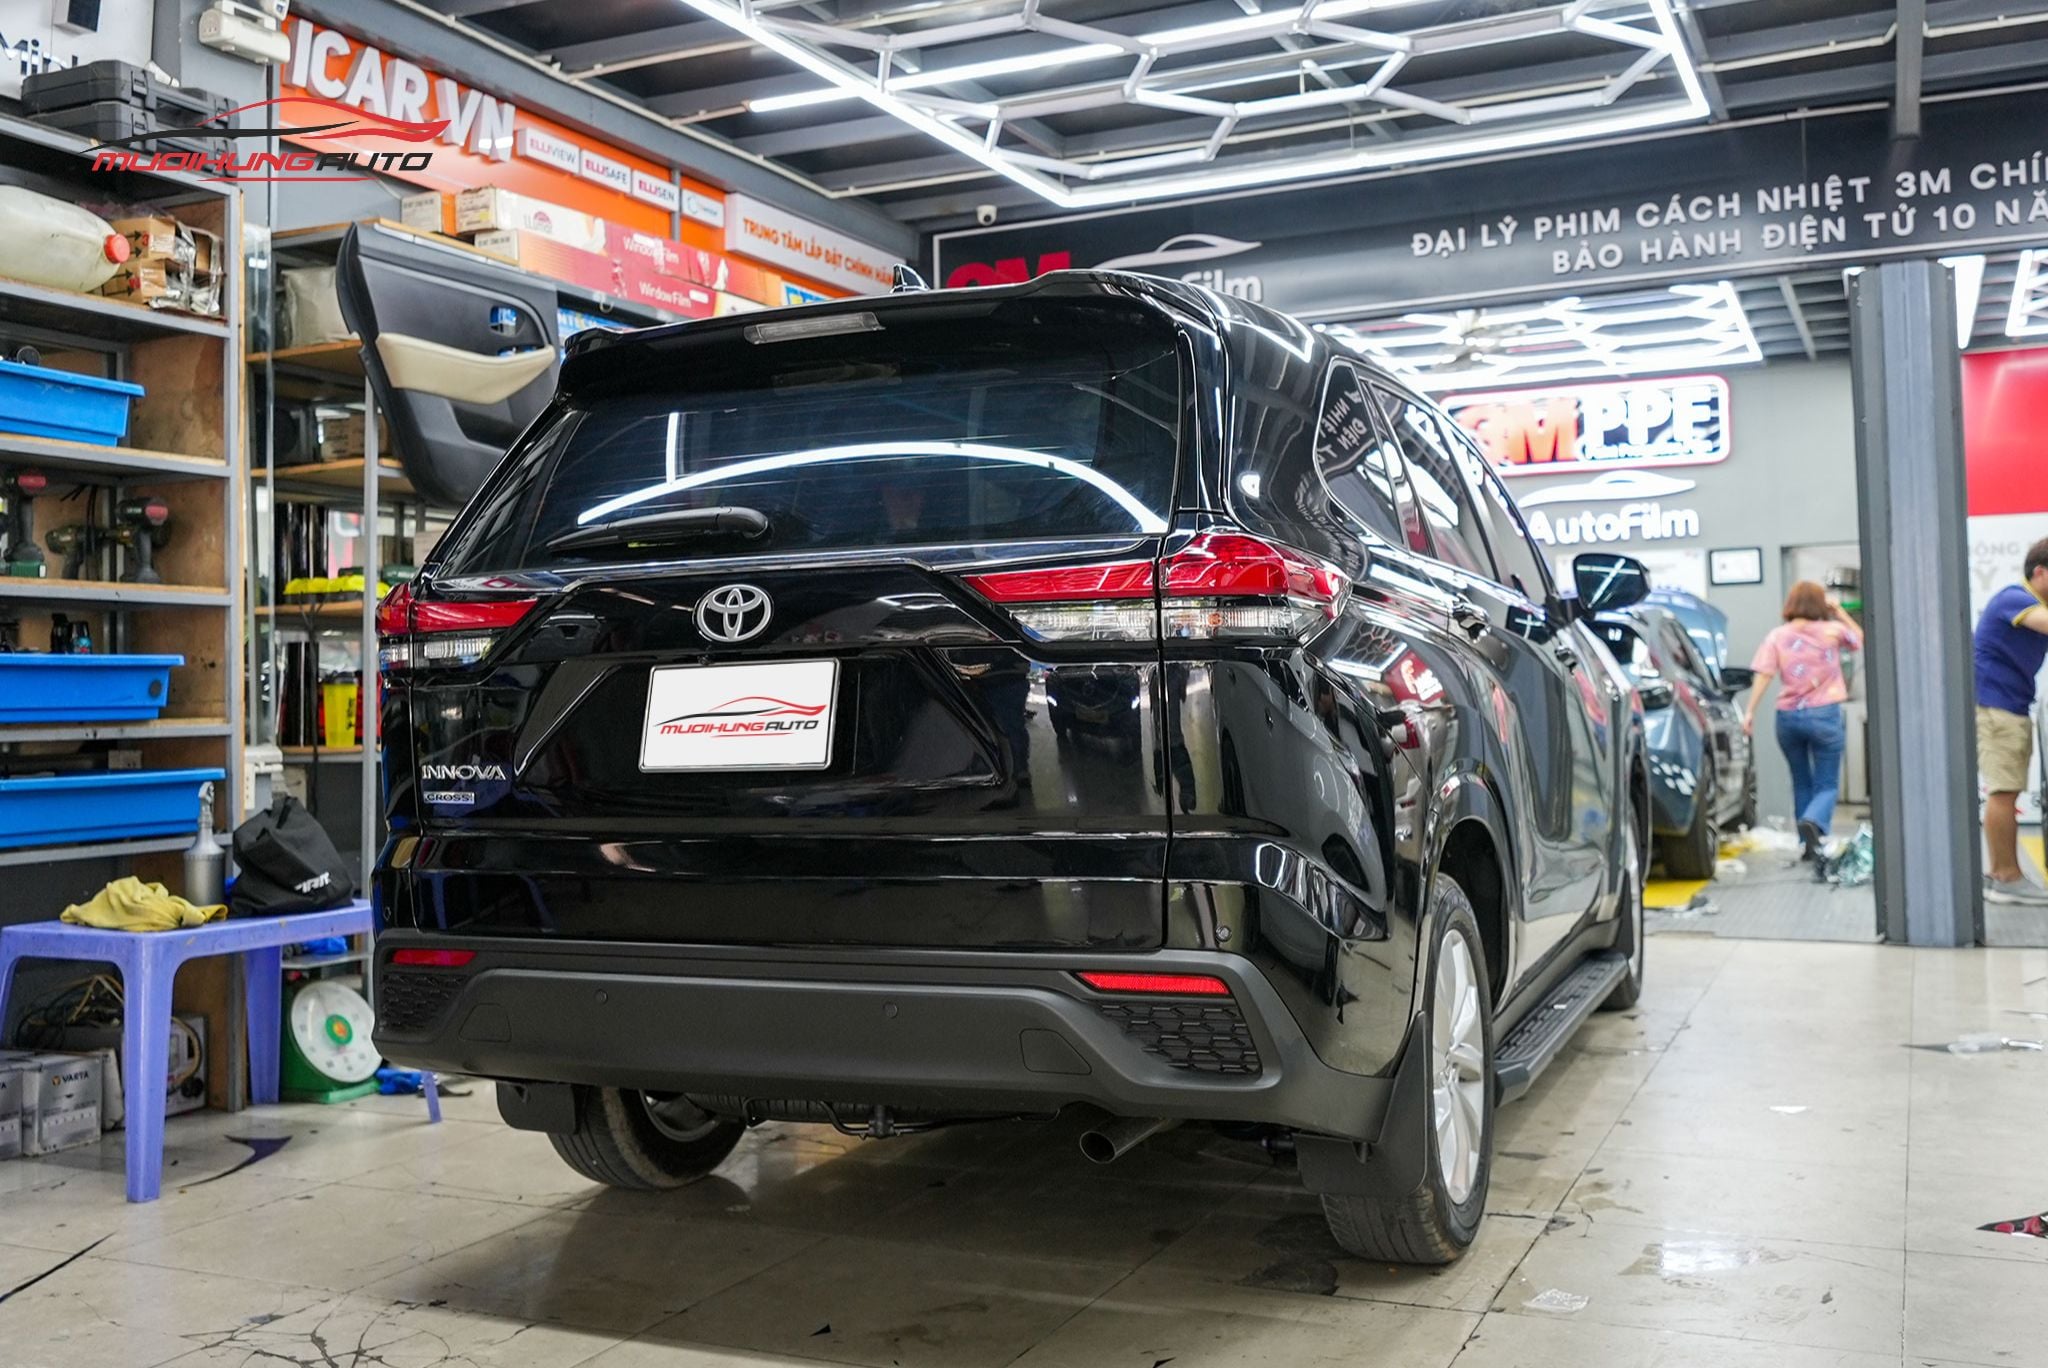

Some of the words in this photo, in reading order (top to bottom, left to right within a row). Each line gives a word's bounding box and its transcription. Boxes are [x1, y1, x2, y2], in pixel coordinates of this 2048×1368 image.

[1411, 227, 1466, 258] ĐẠI
[1533, 207, 1621, 241] PHIM
[1636, 192, 1742, 229] CÁCH
[1757, 174, 1871, 214] NHIỆT
[1895, 167, 1951, 198] 3M
[1969, 151, 2048, 190] CHÍ
[743, 218, 779, 245] TRUNG
[781, 230, 803, 252] TÂM
[1552, 240, 1624, 274] BẢO
[1641, 229, 1742, 264] HÀNH
[1761, 213, 1847, 251] ĐIỆN
[1863, 202, 1917, 239] TỬ
[1933, 202, 1976, 232] 10
[1528, 502, 1699, 546] AutoFilm
[421, 764, 506, 780] INNOVA
[426, 792, 472, 802] CROSS
[62, 1071, 89, 1084] VARTA
